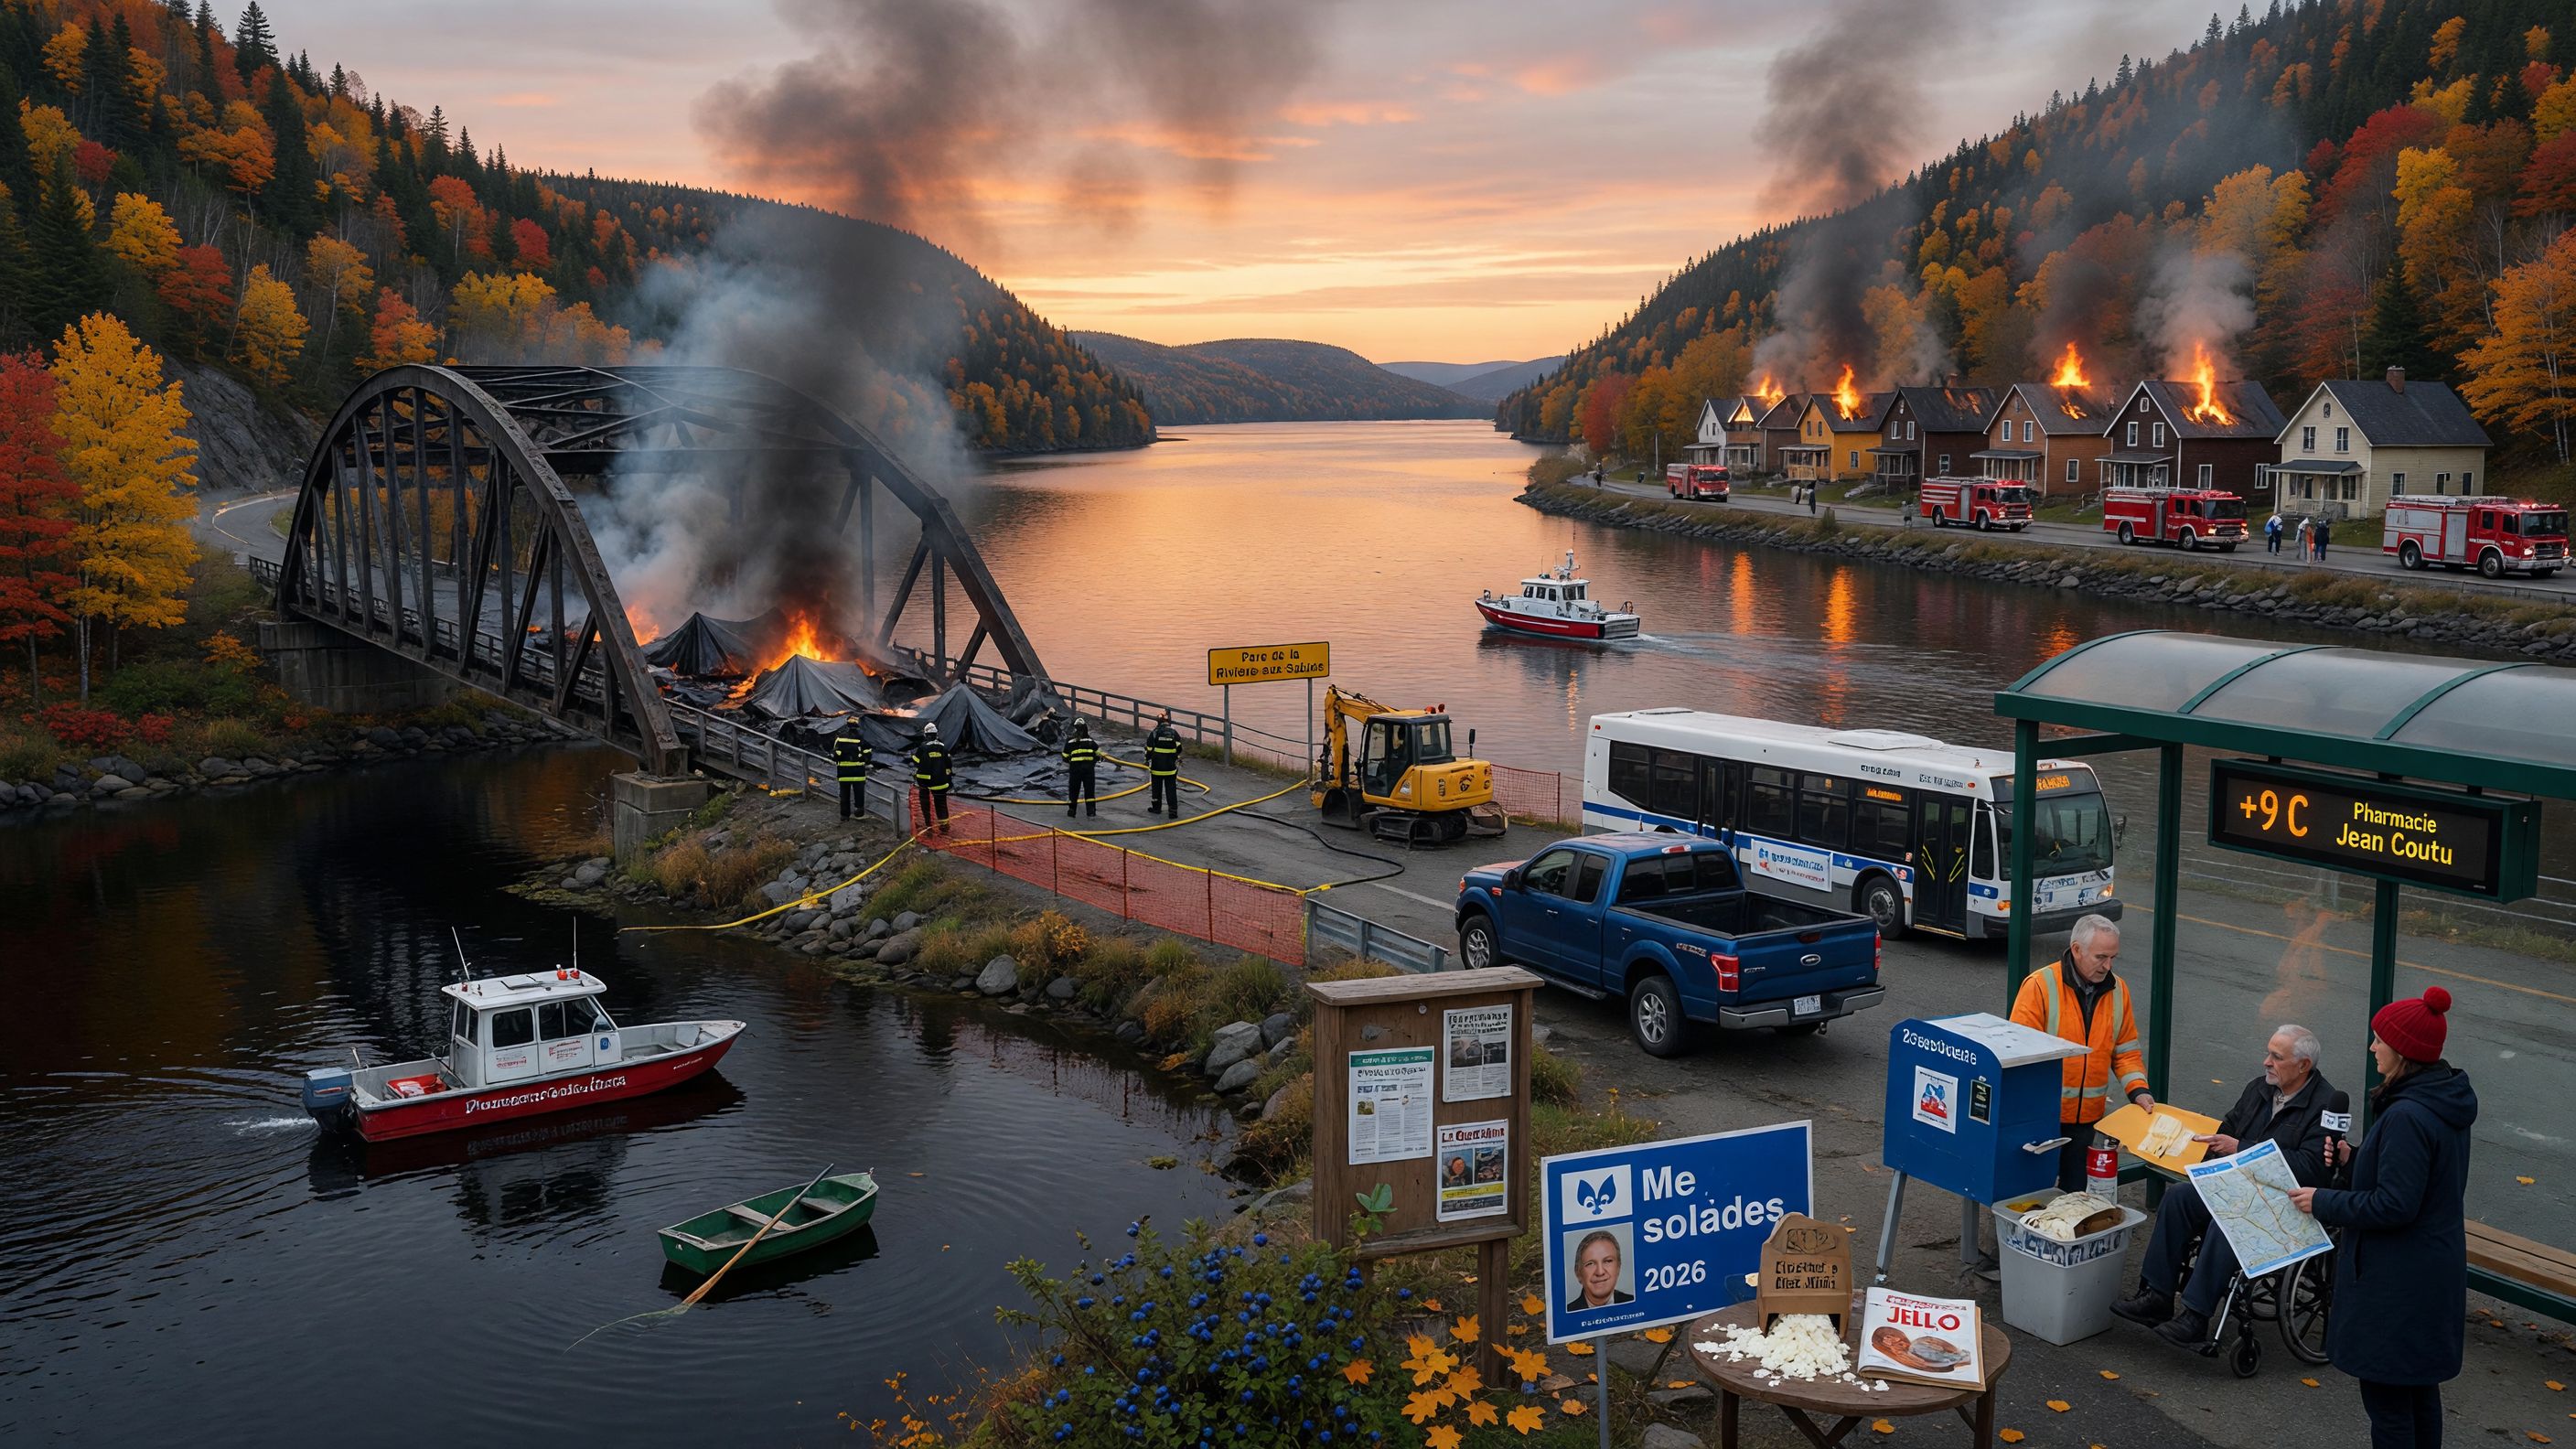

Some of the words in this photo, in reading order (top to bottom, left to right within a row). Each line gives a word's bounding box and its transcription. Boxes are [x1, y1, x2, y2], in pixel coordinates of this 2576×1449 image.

[2238, 789, 2279, 832] +9
[2287, 794, 2308, 837] C
[2354, 801, 2437, 834] Pharmacie
[2335, 822, 2384, 853] Jean
[2390, 833, 2453, 865] Coutu
[1642, 1165, 1696, 1202] Me
[1644, 1260, 1706, 1293] 2026
[1886, 1306, 1960, 1331] JELLO
